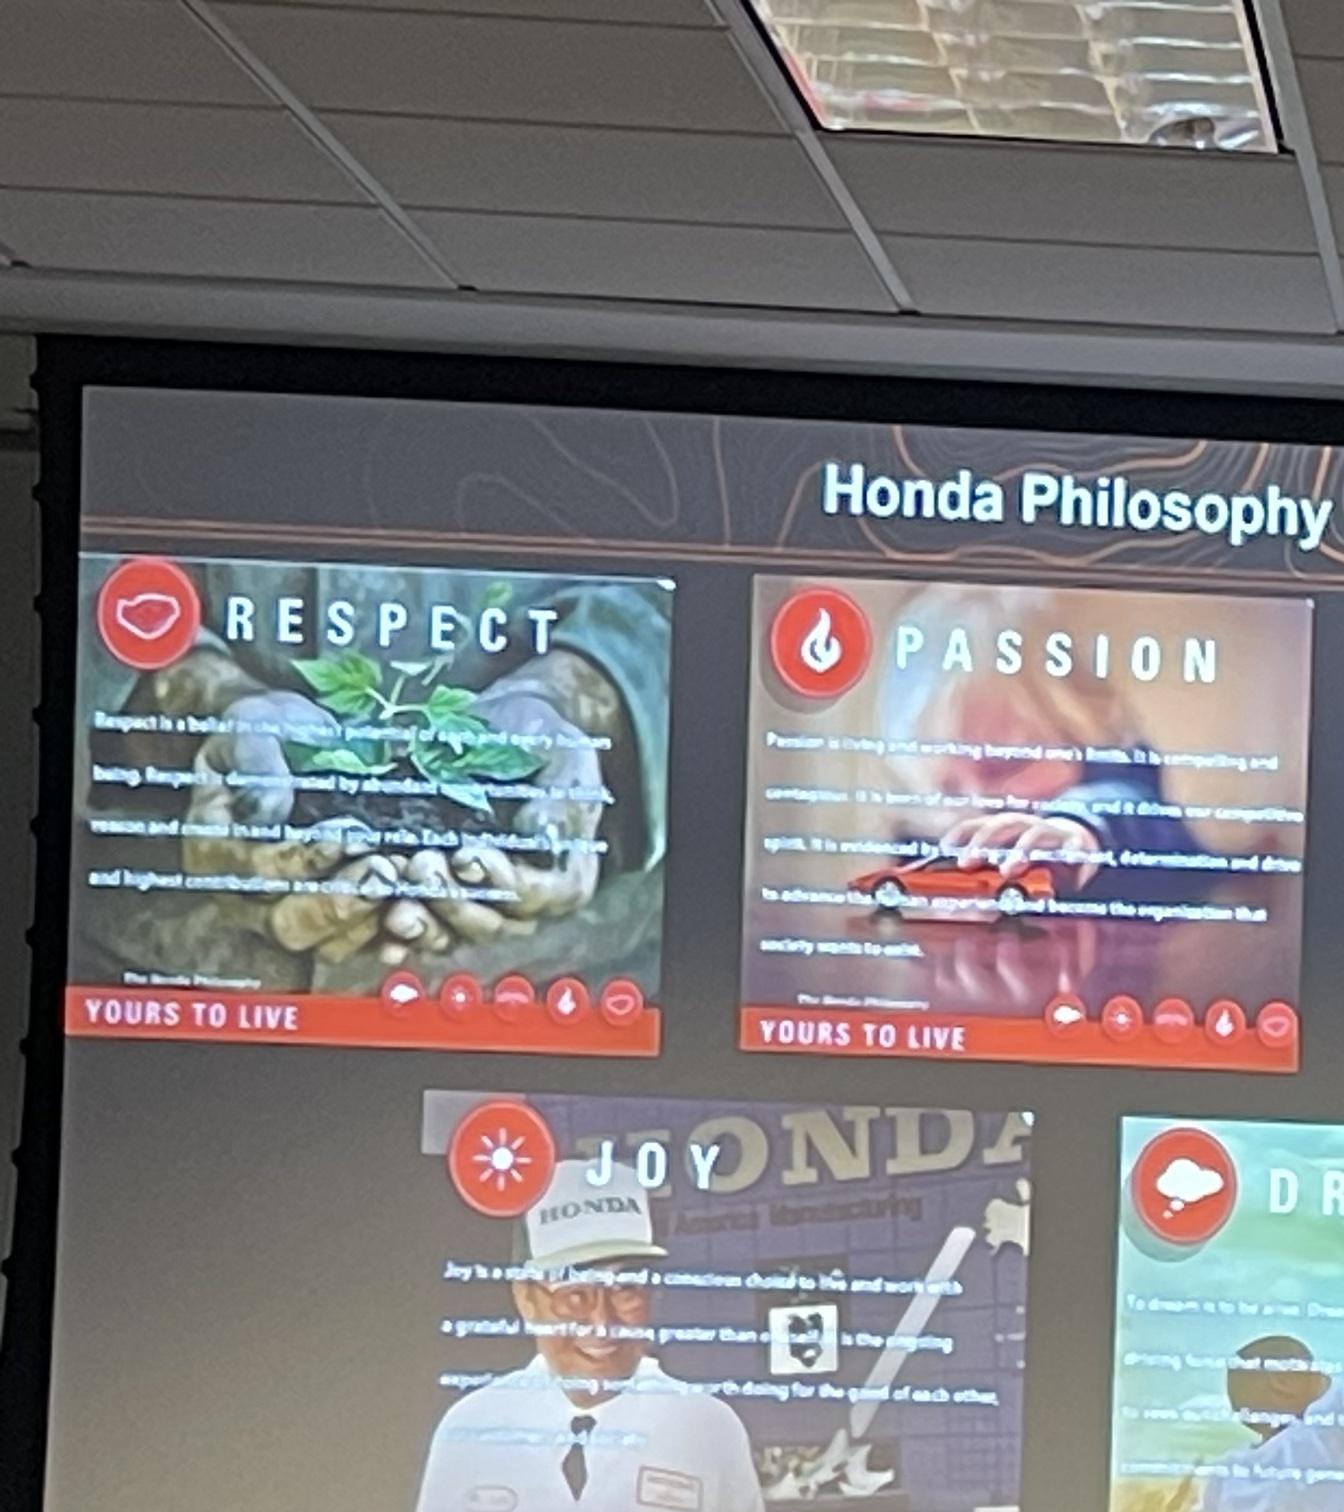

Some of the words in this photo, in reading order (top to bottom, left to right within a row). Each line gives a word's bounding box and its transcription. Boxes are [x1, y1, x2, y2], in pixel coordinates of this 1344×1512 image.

[823, 462, 1004, 523] Honda
[1021, 473, 1333, 550] Philosophy
[226, 596, 559, 655] RESPECT
[894, 626, 1217, 683] PASSION
[85, 999, 181, 1025] YOURS
[192, 1003, 226, 1027] TO
[239, 1005, 298, 1030] LIVE
[760, 1020, 850, 1045] YOURS
[863, 1023, 896, 1048] TO
[908, 1026, 966, 1050] LIVE
[586, 1142, 719, 1190] JOY
